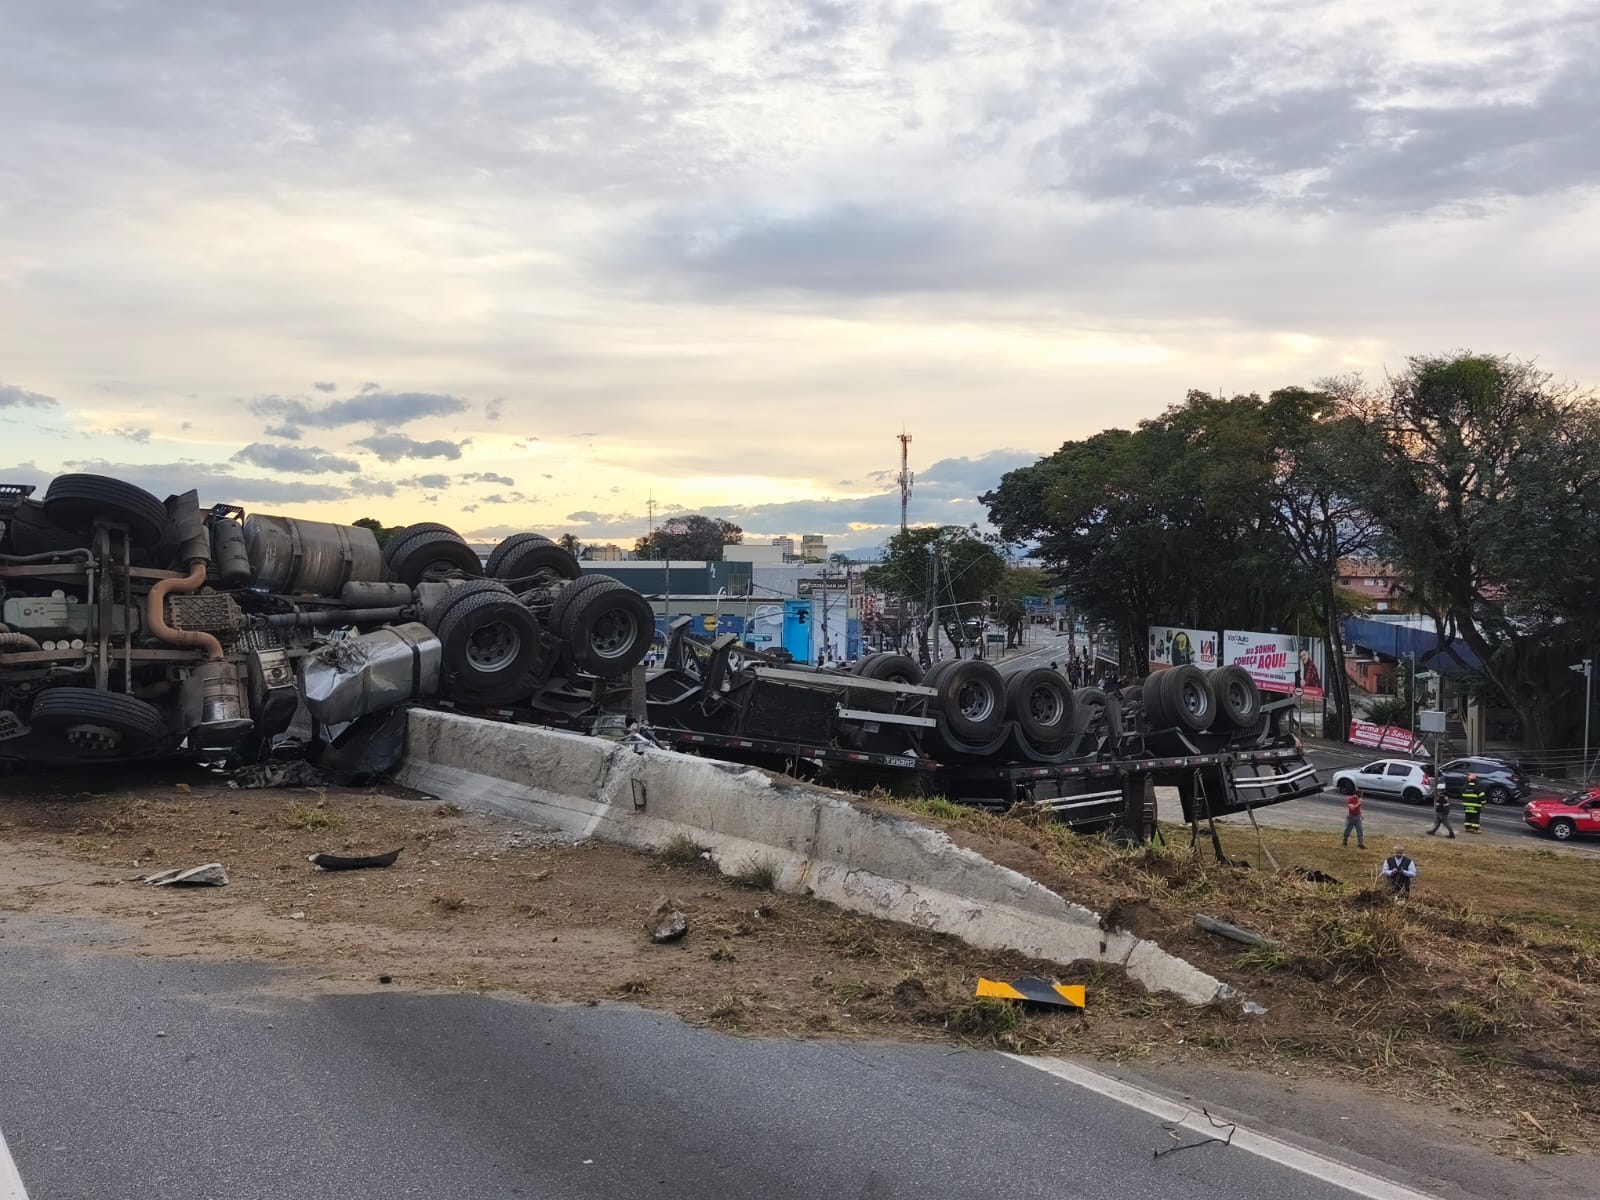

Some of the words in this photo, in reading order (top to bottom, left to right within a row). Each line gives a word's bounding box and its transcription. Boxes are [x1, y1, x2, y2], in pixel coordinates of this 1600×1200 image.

[1254, 644, 1276, 655] SONHO
[1233, 656, 1257, 667] COMEÇA
[1257, 652, 1287, 670] AQUI!
